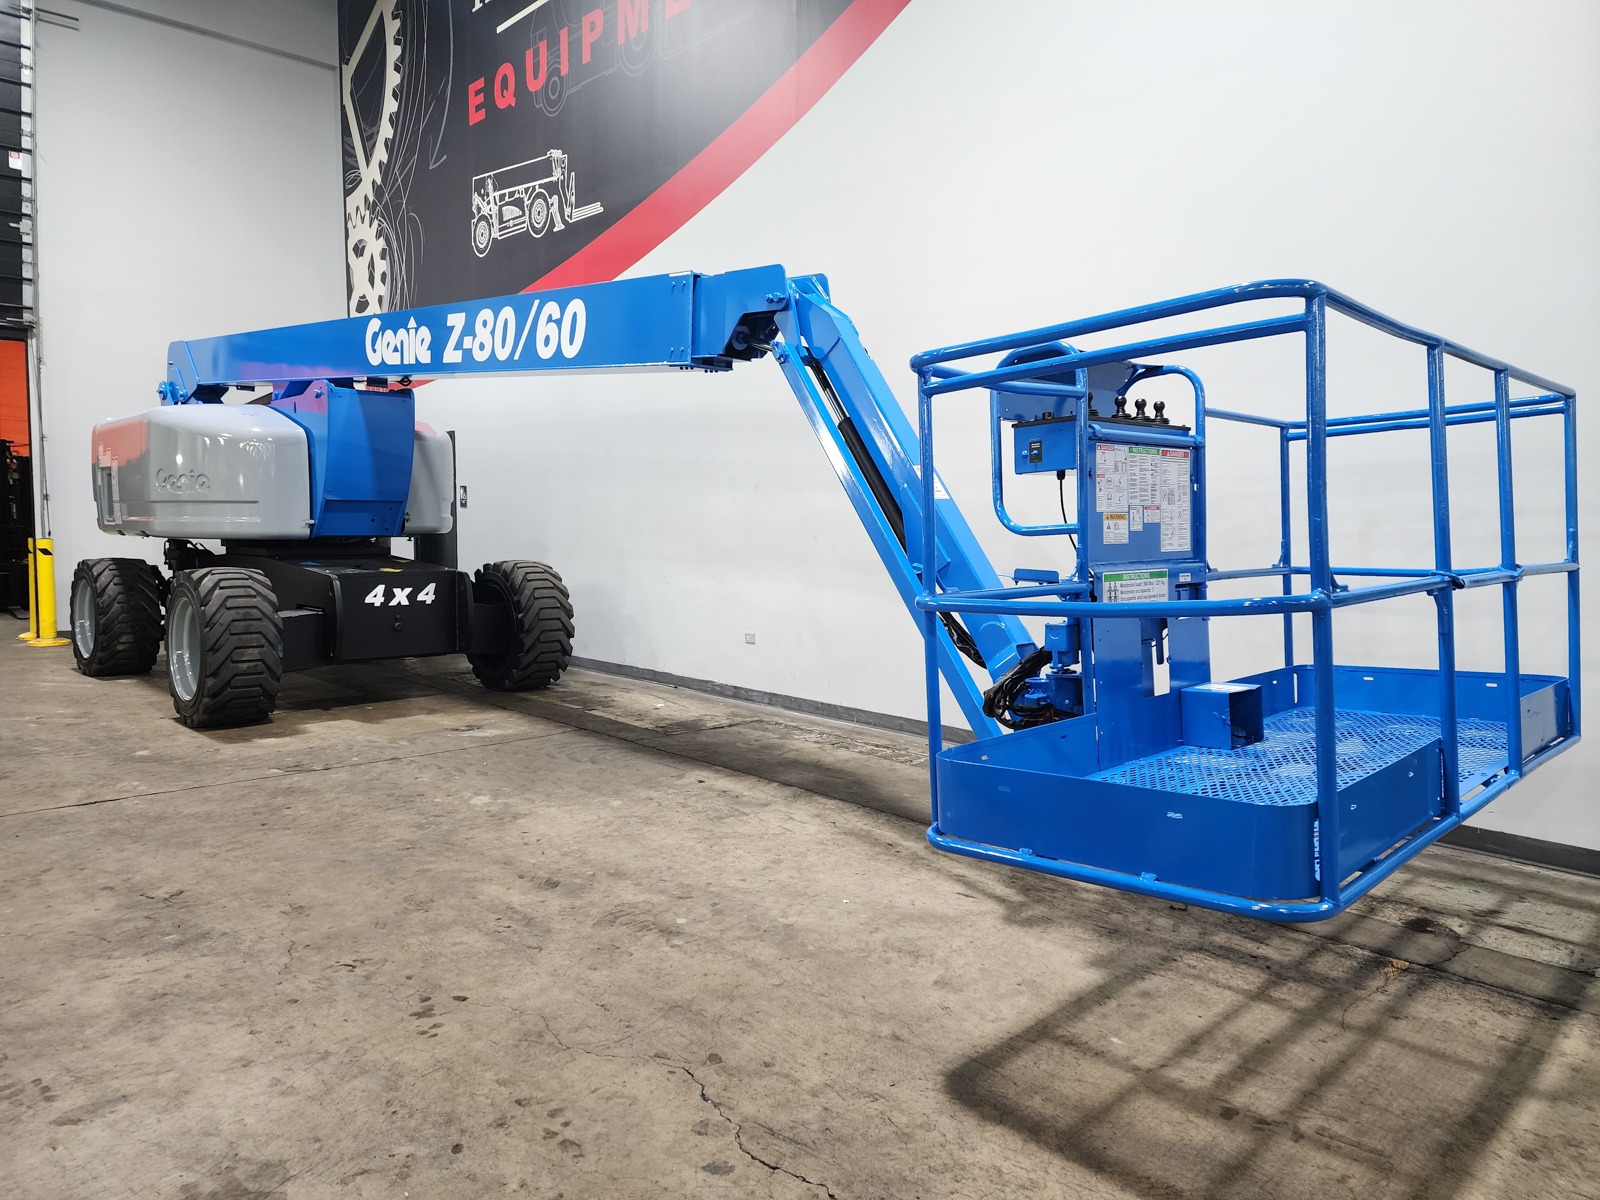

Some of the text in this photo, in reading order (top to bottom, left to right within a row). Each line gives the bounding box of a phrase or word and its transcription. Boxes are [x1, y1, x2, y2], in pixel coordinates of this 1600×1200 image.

[365, 298, 587, 366] Genie Z-80/60
[1132, 447, 1158, 455] INSTRUCTIONS
[1169, 450, 1184, 458] DANGER
